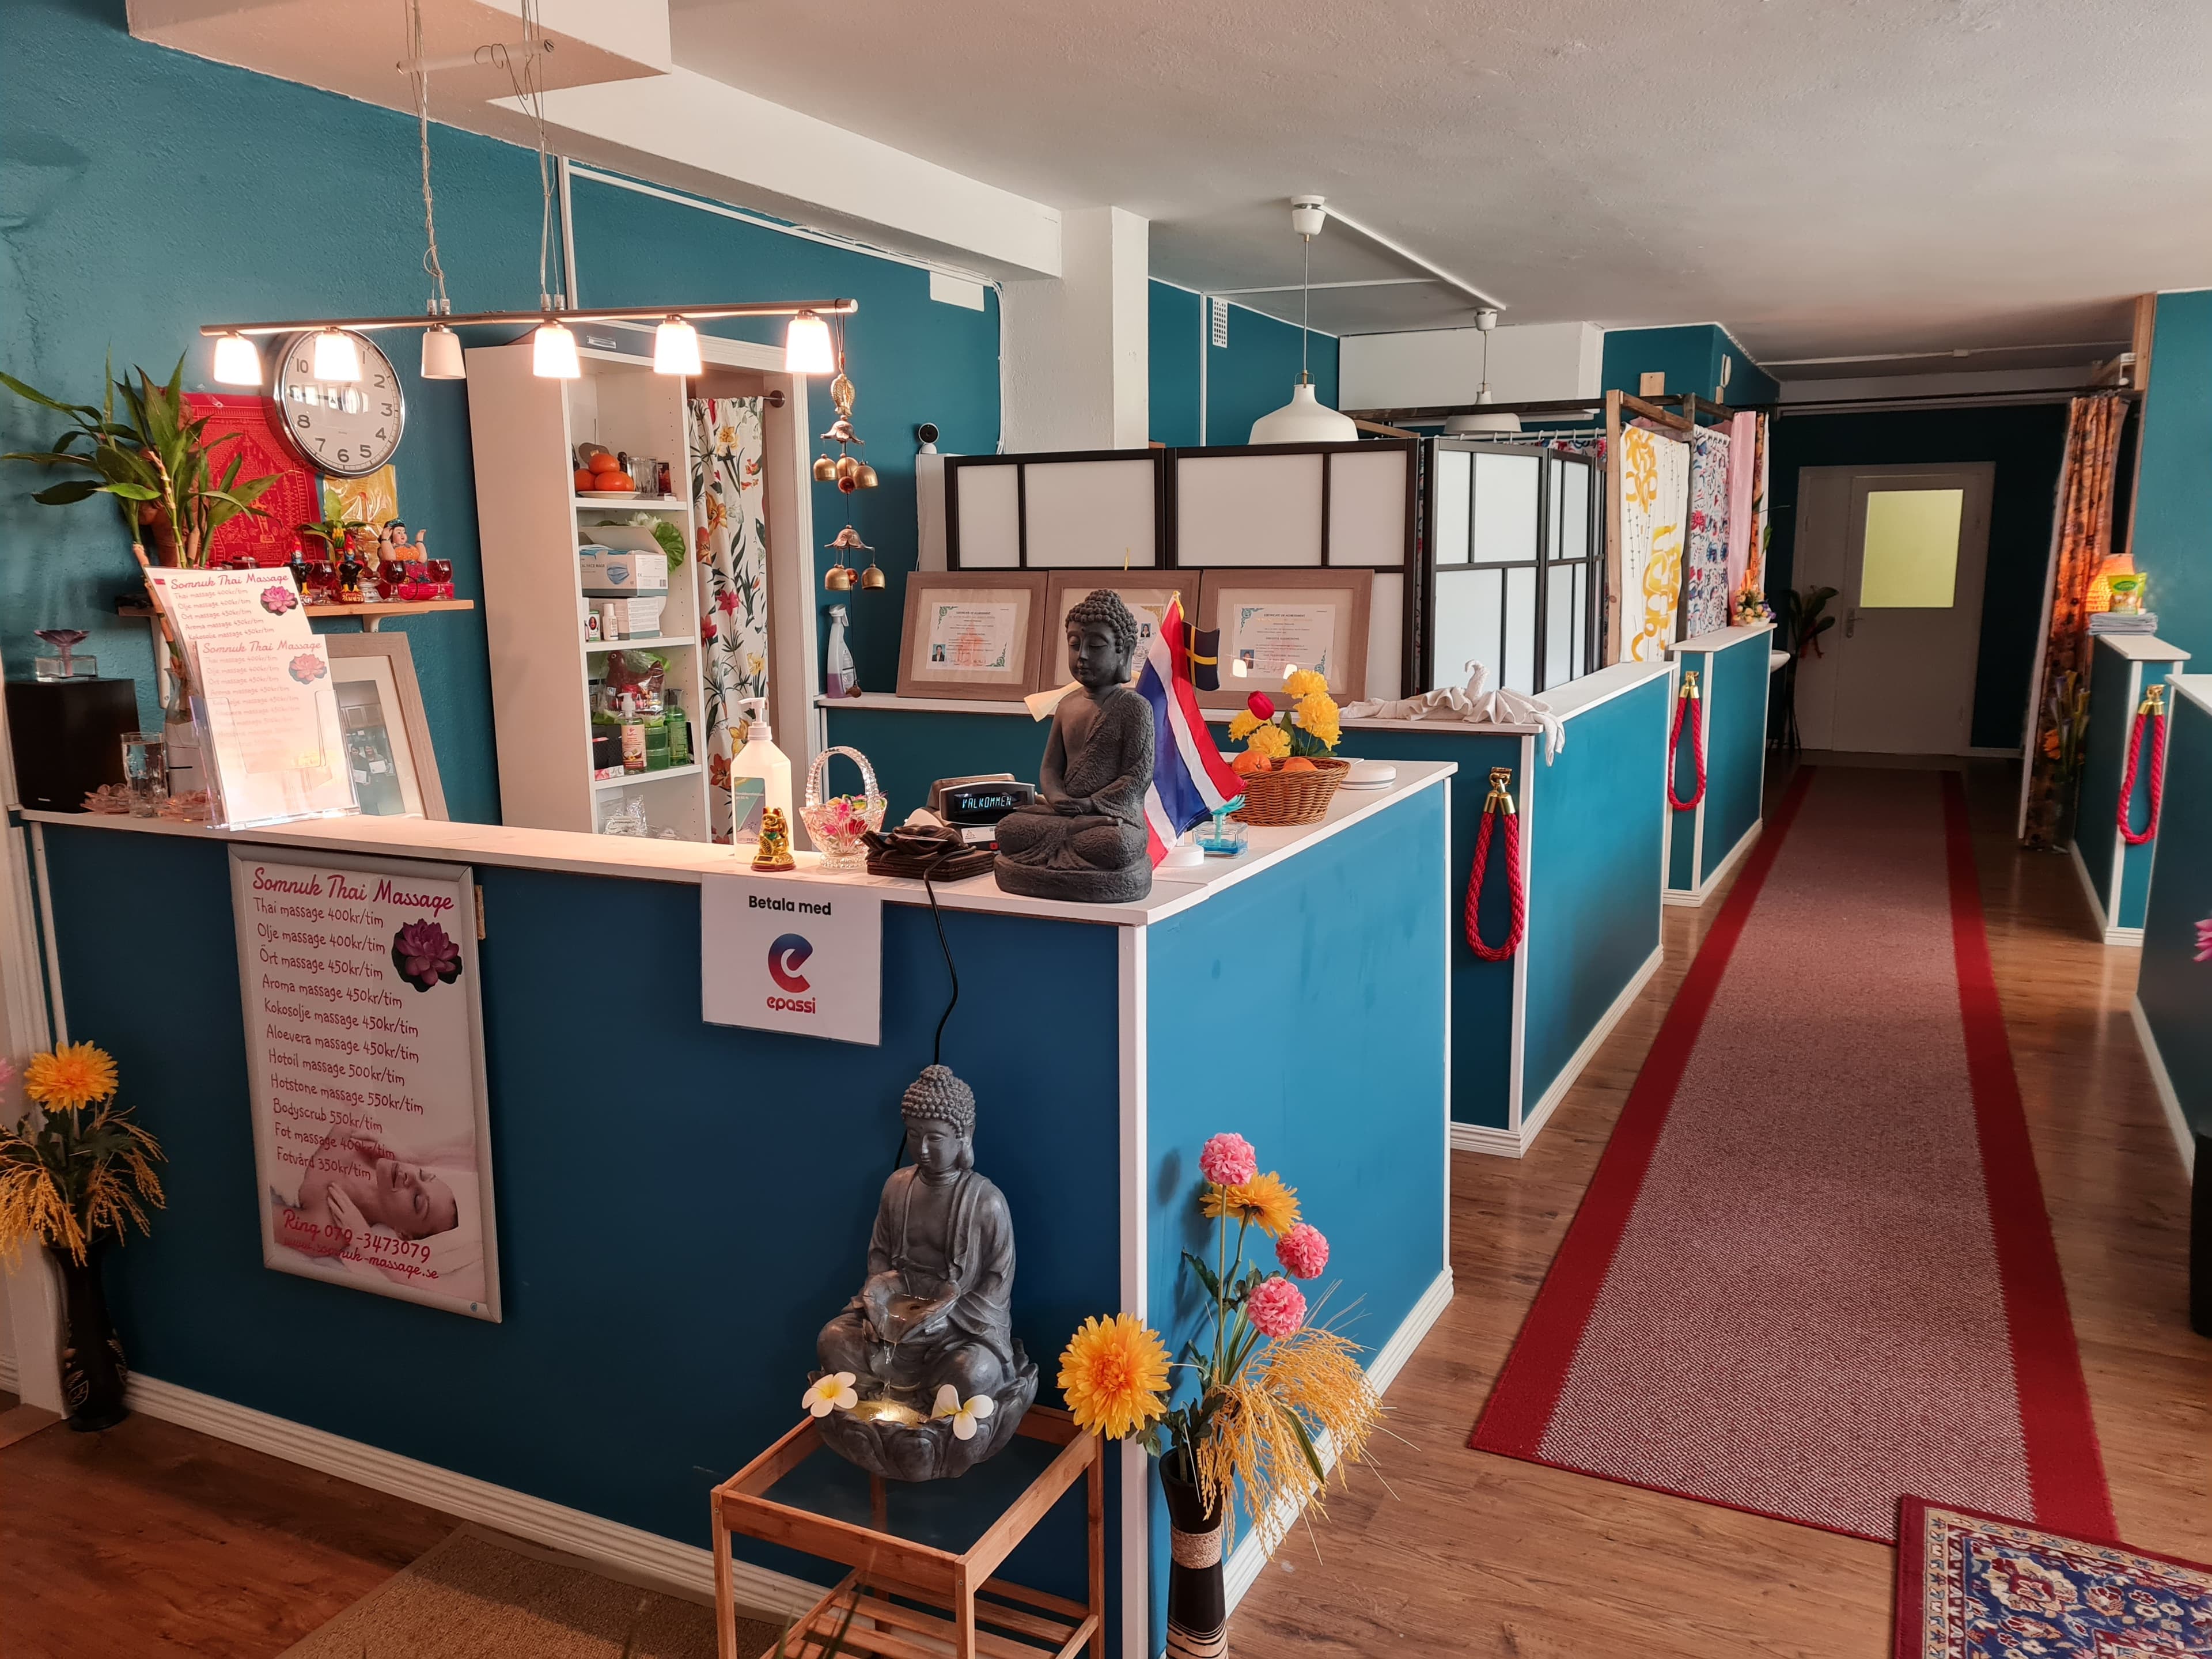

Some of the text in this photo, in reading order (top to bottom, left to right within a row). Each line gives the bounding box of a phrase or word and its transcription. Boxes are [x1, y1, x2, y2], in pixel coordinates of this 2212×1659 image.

[297, 358, 308, 374] 10
[374, 374, 385, 389] 2
[297, 415, 310, 429] 8
[381, 403, 392, 417] 3
[315, 438, 325, 452] 7
[376, 427, 386, 441] 4
[338, 449, 349, 463] 6
[360, 445, 372, 458] 5
[171, 573, 289, 589] Somnuk Thai Massage
[203, 642, 246, 654] Somnuk
[249, 641, 273, 652] Thai
[277, 641, 321, 653] Massage
[253, 867, 454, 917] Somnuk Thai Massage
[749, 895, 831, 915] Betala med
[254, 897, 384, 928] Thai massage 400kr/tim
[257, 922, 385, 954] Olje massage 400kr/tim
[260, 944, 383, 980] Ört massage 450kr/tim
[263, 974, 402, 1009] Aroma massage 450kr/tim
[767, 997, 816, 1014] epassi
[264, 998, 418, 1037] Kokosolje massage 450kr/tim
[267, 1024, 419, 1063] Aloevera massage 450kr/tim
[268, 1048, 405, 1086] Hotoil massage 500kr/tim
[271, 1074, 423, 1115] Hotstone massage 550kr/tim
[273, 1097, 382, 1133] Bodyscrub 550kr/tim
[275, 1122, 395, 1160] Fot massage 400kr/tim
[277, 1147, 371, 1180] Fotvård 350kr/tim
[283, 1209, 320, 1237] Ring
